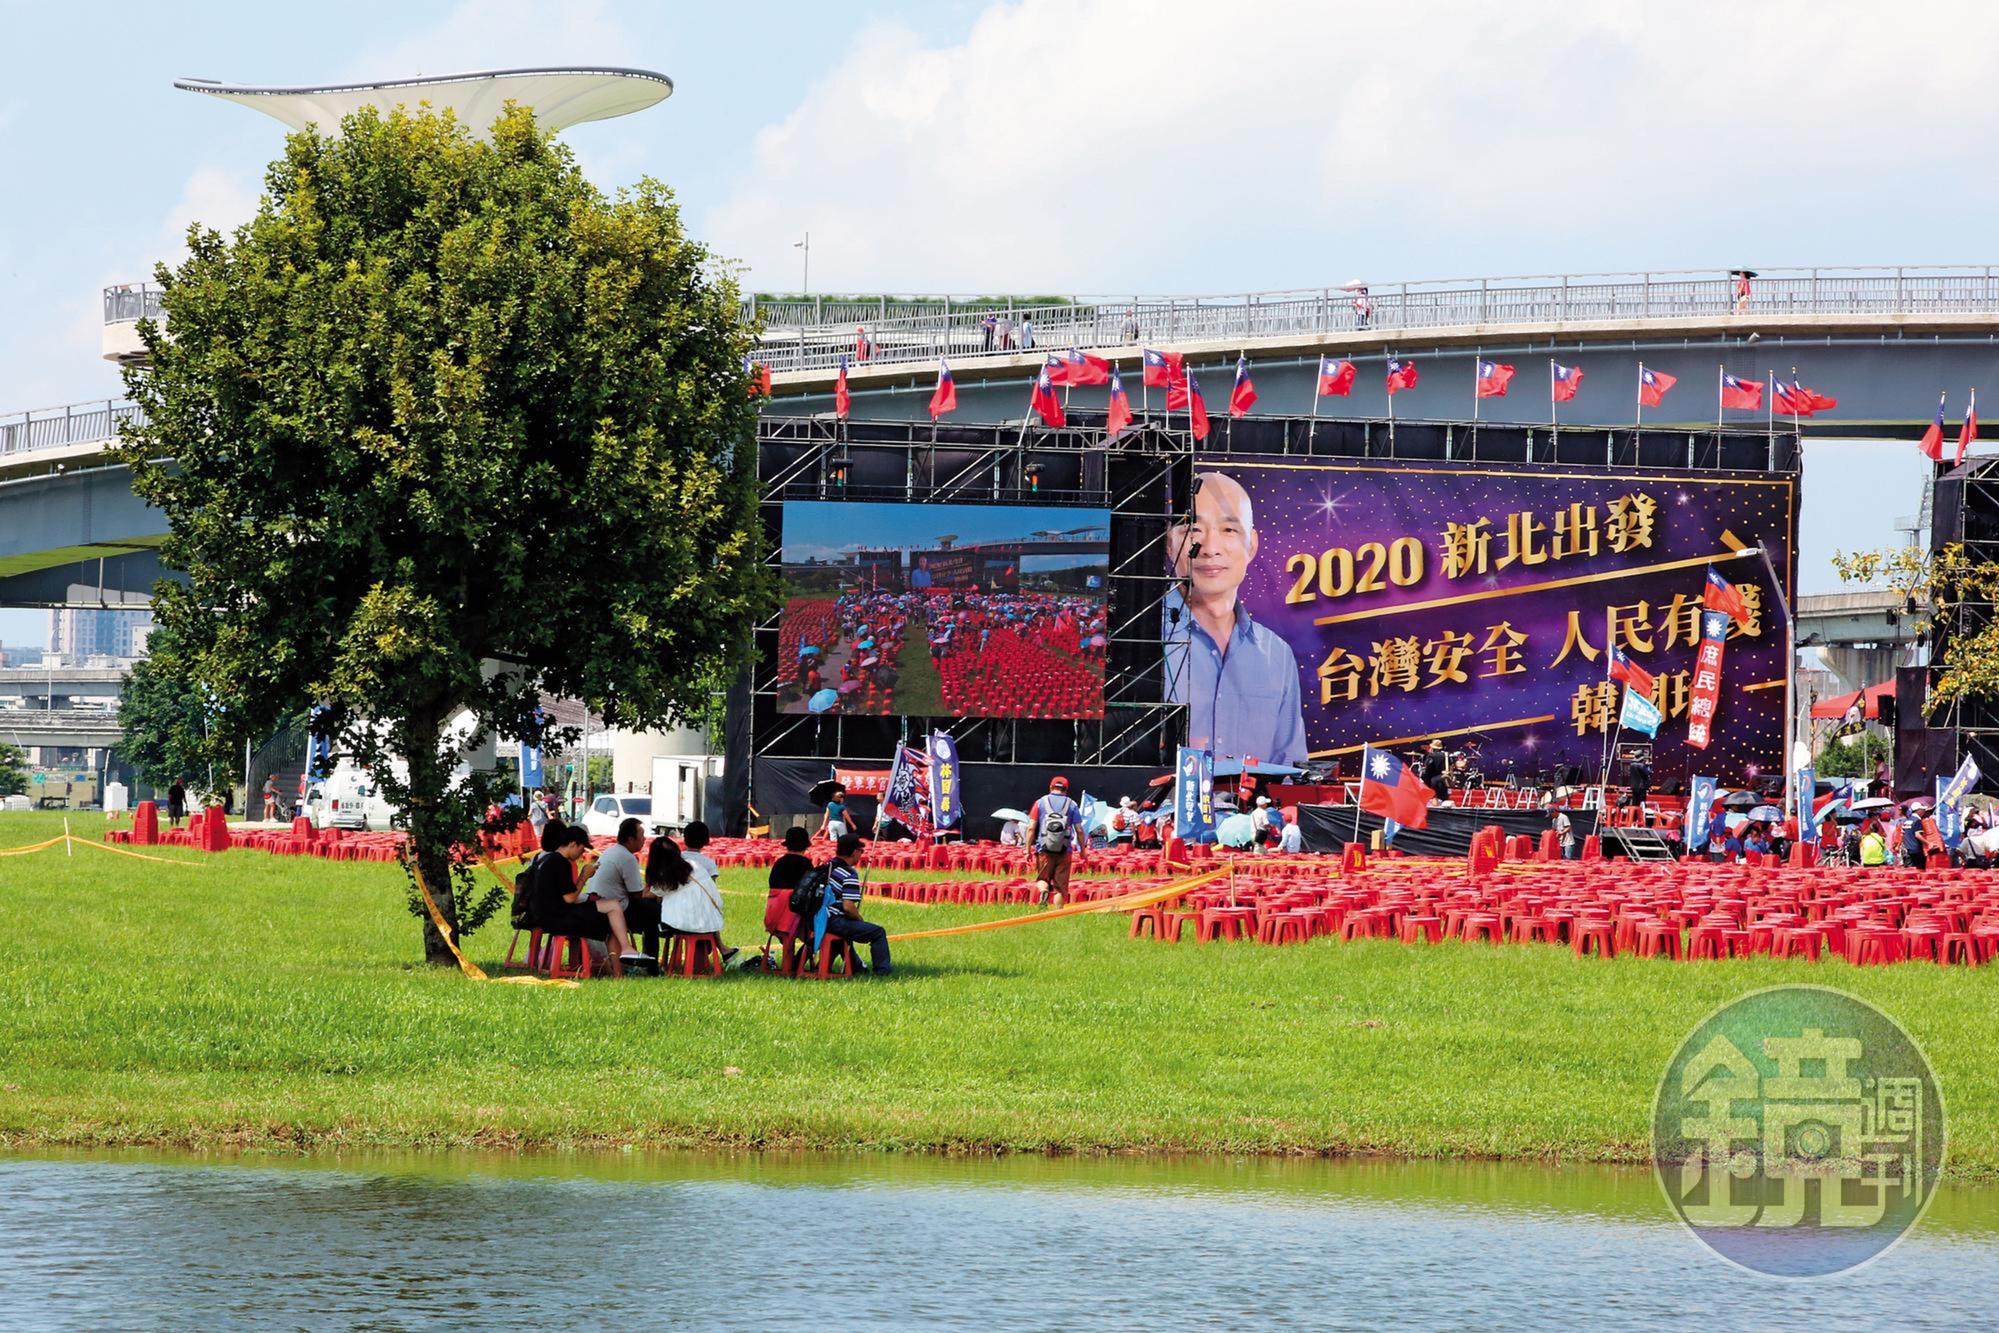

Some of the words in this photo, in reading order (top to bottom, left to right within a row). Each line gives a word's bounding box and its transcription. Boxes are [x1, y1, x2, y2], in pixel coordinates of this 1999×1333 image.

[1285, 535, 1424, 605] 2020
[1439, 492, 1657, 579] 新北出發
[1317, 620, 1529, 705] 台灣安全
[1688, 644, 1720, 743] 庶民總統
